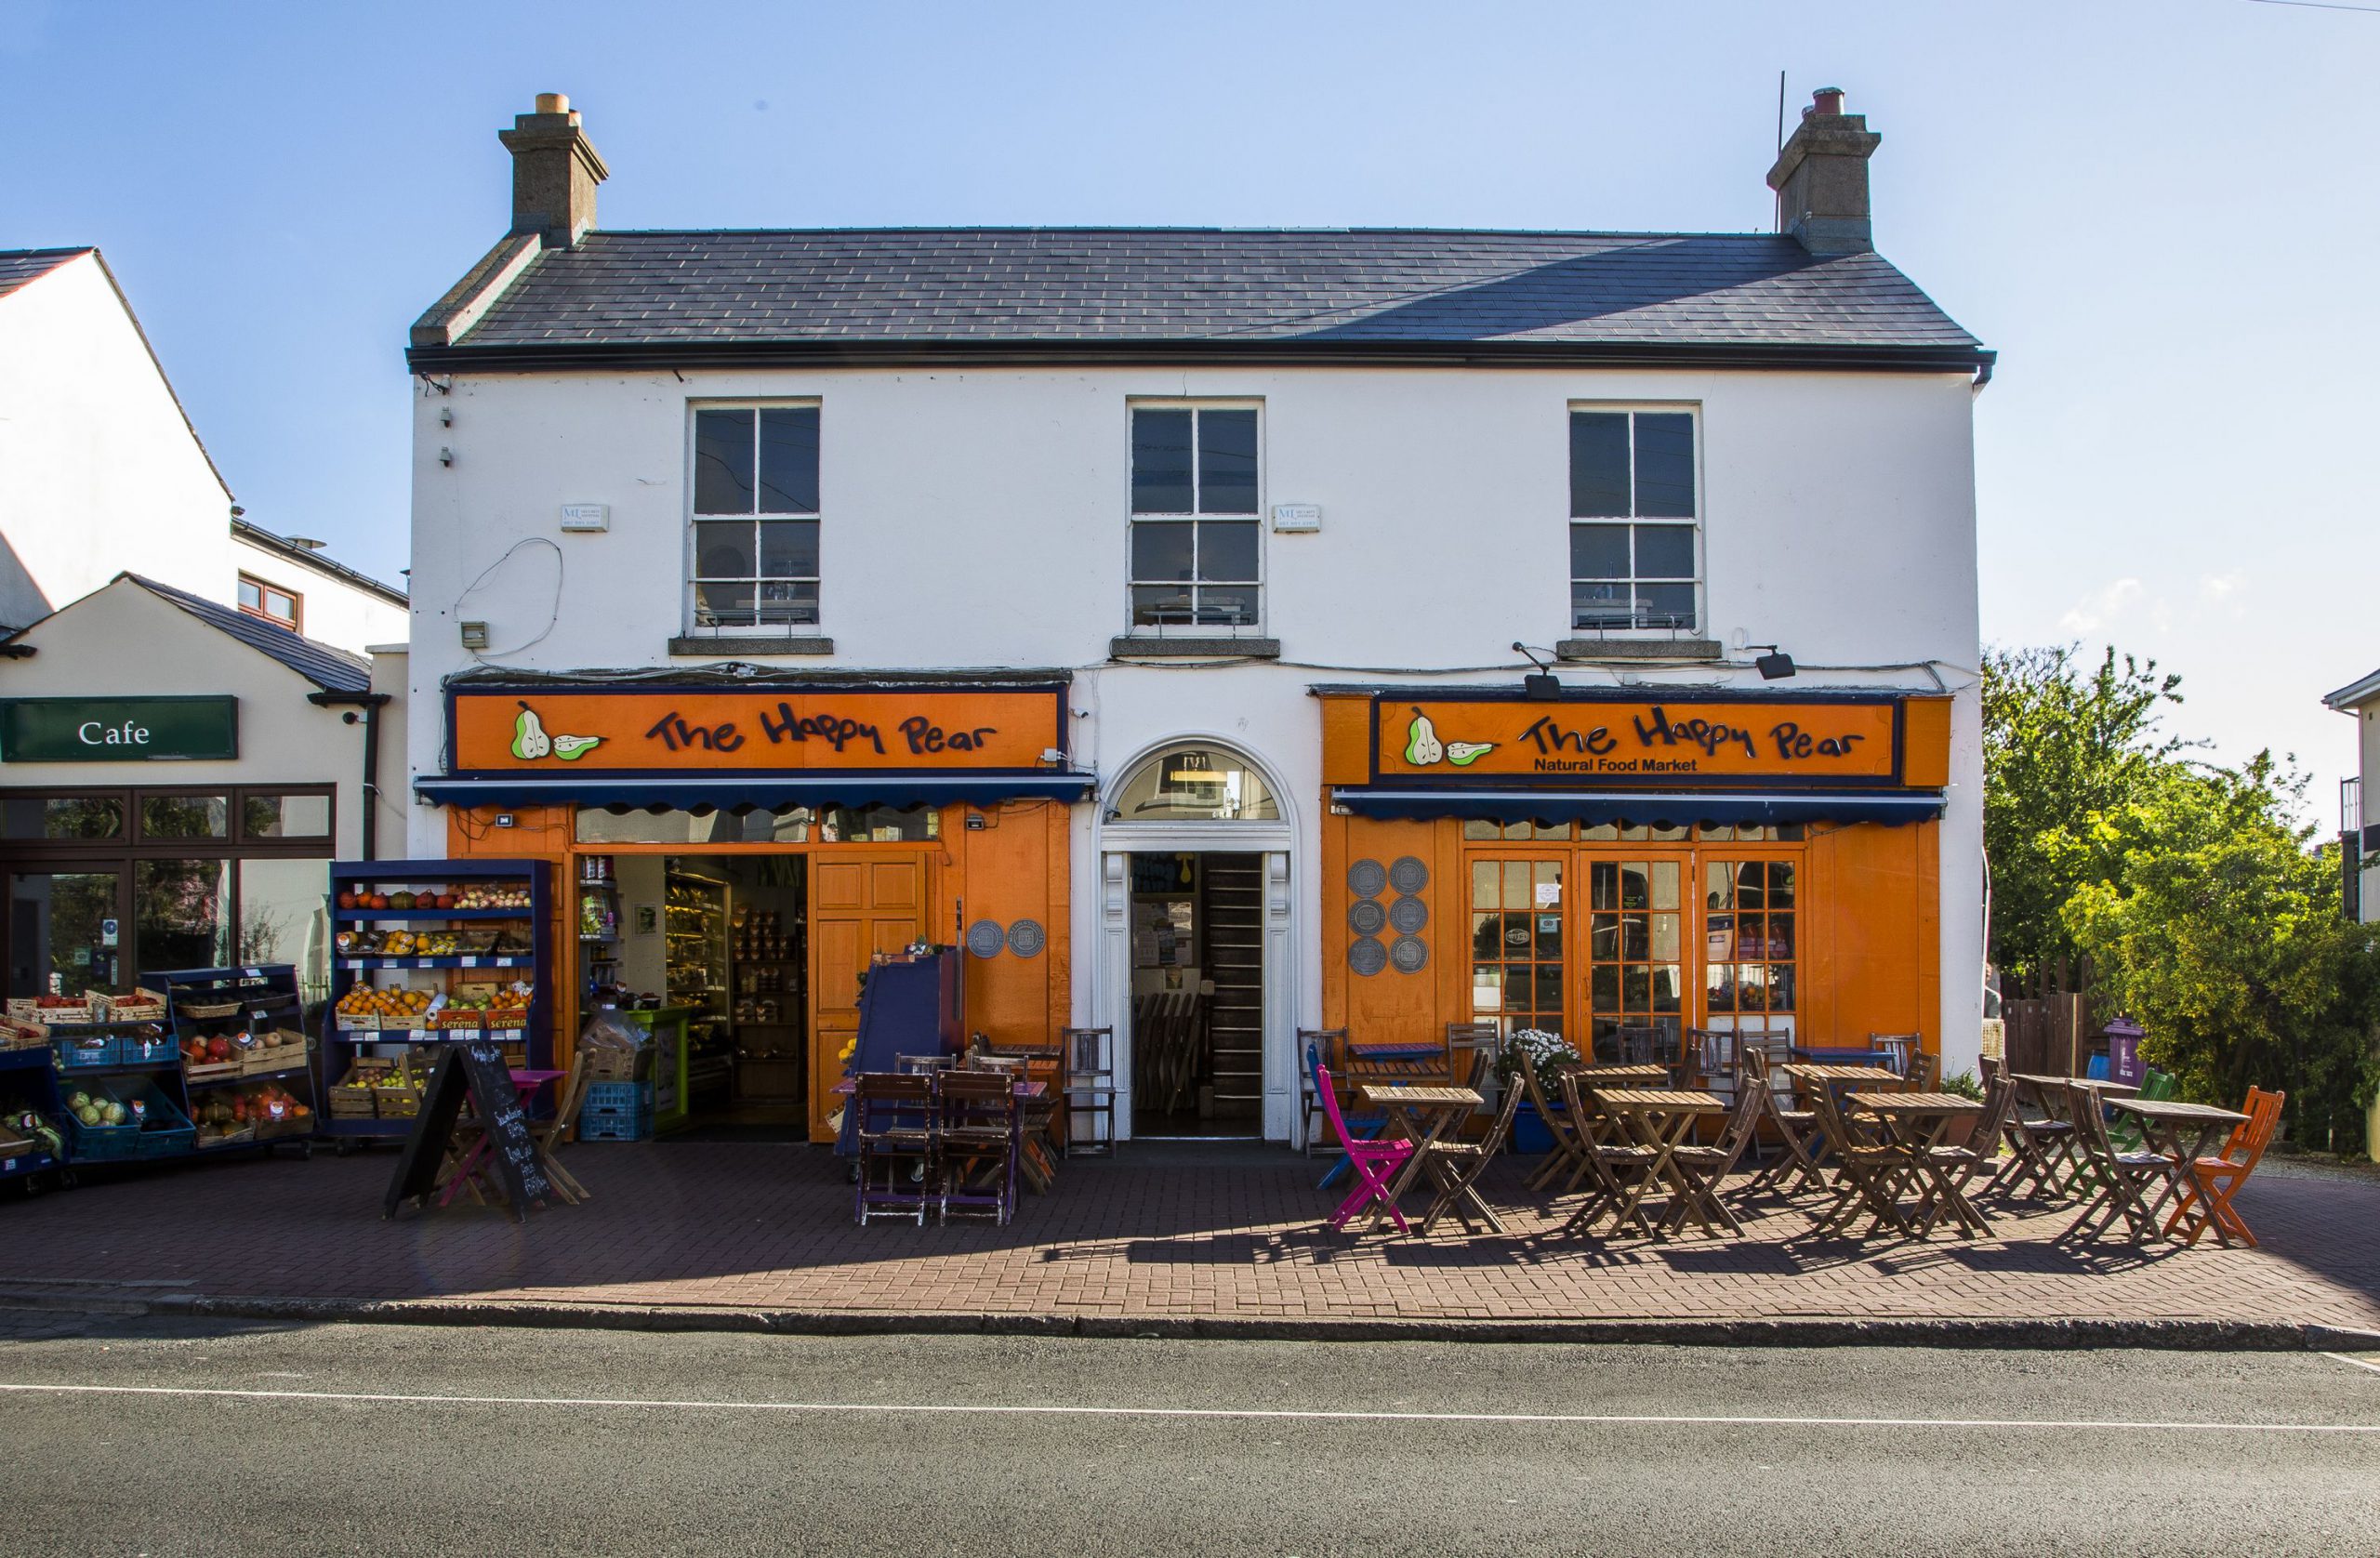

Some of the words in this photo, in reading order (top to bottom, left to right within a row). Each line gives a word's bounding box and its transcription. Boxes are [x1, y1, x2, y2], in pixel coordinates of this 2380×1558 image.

[78, 720, 150, 746] Cafe
[645, 711, 747, 753] The
[760, 702, 887, 755] Happy
[898, 716, 998, 755] Pear
[1517, 715, 1619, 756] The
[1632, 705, 1757, 759] Happy
[1769, 722, 1866, 760] Pear
[1534, 758, 1593, 772] Natural
[1598, 758, 1637, 772] Food
[1642, 758, 1698, 772] Market
[442, 1020, 479, 1029] serena
[491, 1019, 527, 1028] serena
